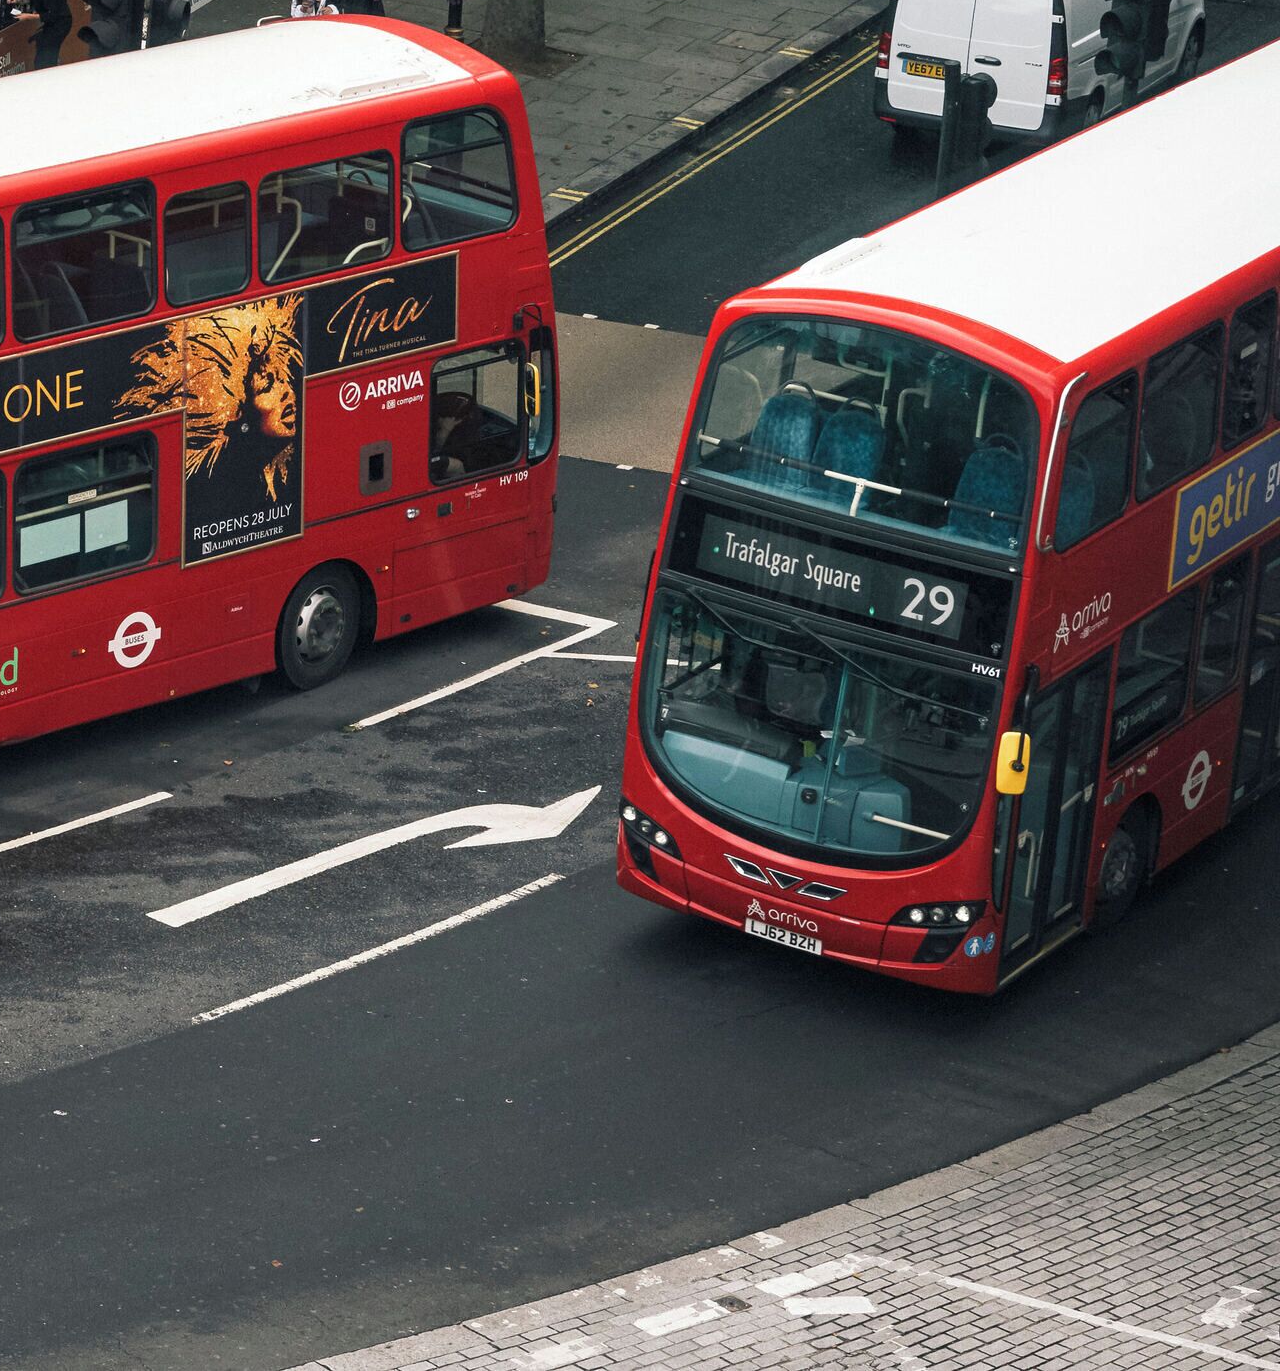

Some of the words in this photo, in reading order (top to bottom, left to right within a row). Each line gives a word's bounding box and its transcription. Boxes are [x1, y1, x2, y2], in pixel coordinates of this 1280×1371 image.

[908, 63, 933, 77] YE67
[326, 277, 433, 363] Tina
[364, 347, 378, 355] TINA
[379, 341, 401, 351] TURNER
[401, 335, 427, 345] MUSICAL
[3, 369, 84, 423] ONE
[364, 370, 424, 400] ARRIVA
[396, 393, 425, 406] company
[499, 474, 513, 486] HV
[514, 470, 529, 482] 109
[193, 515, 249, 540] REOPENS
[251, 511, 264, 526] 28
[266, 503, 292, 522] JULY
[1187, 466, 1256, 565] getir
[725, 532, 799, 577] Trafalgar
[803, 554, 861, 593] Square
[900, 577, 955, 626] 29
[1072, 592, 1111, 632] arriva
[125, 634, 145, 646] BUSES
[971, 663, 1001, 678] HV61
[1116, 716, 1129, 741] 29
[750, 920, 787, 942] LJ62
[789, 932, 817, 952] BZH
[768, 909, 818, 933] arriva
